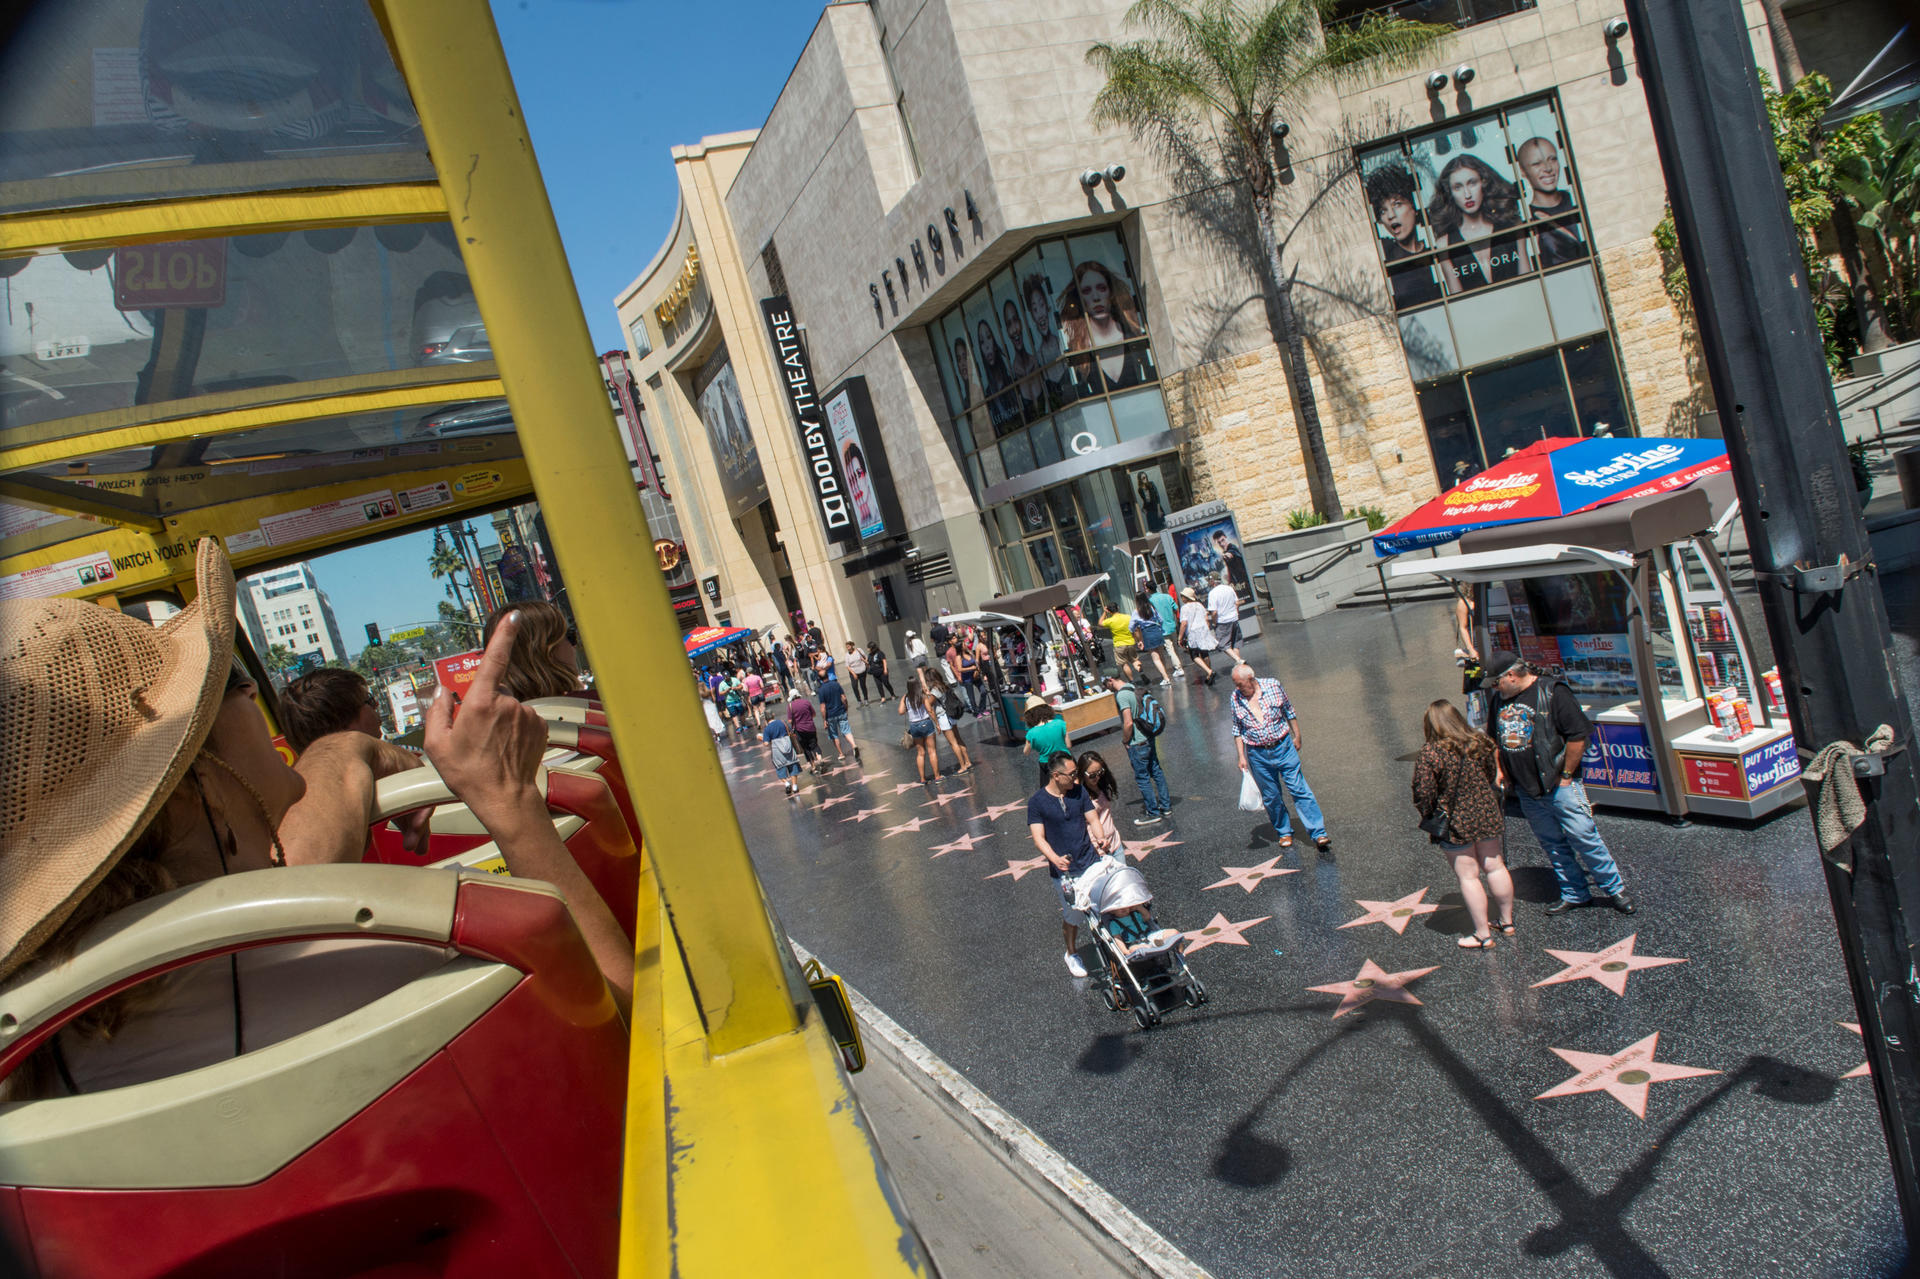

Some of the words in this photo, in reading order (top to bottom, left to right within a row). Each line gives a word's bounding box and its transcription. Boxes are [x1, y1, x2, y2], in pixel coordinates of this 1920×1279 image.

[868, 187, 980, 310] SEPHORA
[771, 309, 815, 415] THEATRE
[801, 419, 838, 494] DOLBY
[1071, 431, 1101, 455] Q
[1563, 443, 1685, 486] Starline
[1590, 470, 1640, 489] TOURS
[1464, 472, 1539, 493] Starline
[1166, 502, 1228, 528] DIRECTORY
[1442, 506, 1462, 517] Hop
[1461, 504, 1478, 515] On
[1477, 502, 1496, 513] Hop
[1495, 499, 1519, 510] Off
[113, 551, 152, 572] WATCH
[154, 543, 187, 562] YOUR
[187, 534, 220, 554] HD
[1599, 743, 1653, 760] TOURS
[1744, 752, 1762, 769] BUY
[1763, 736, 1796, 760] TICKET
[1747, 756, 1801, 792] Starline
